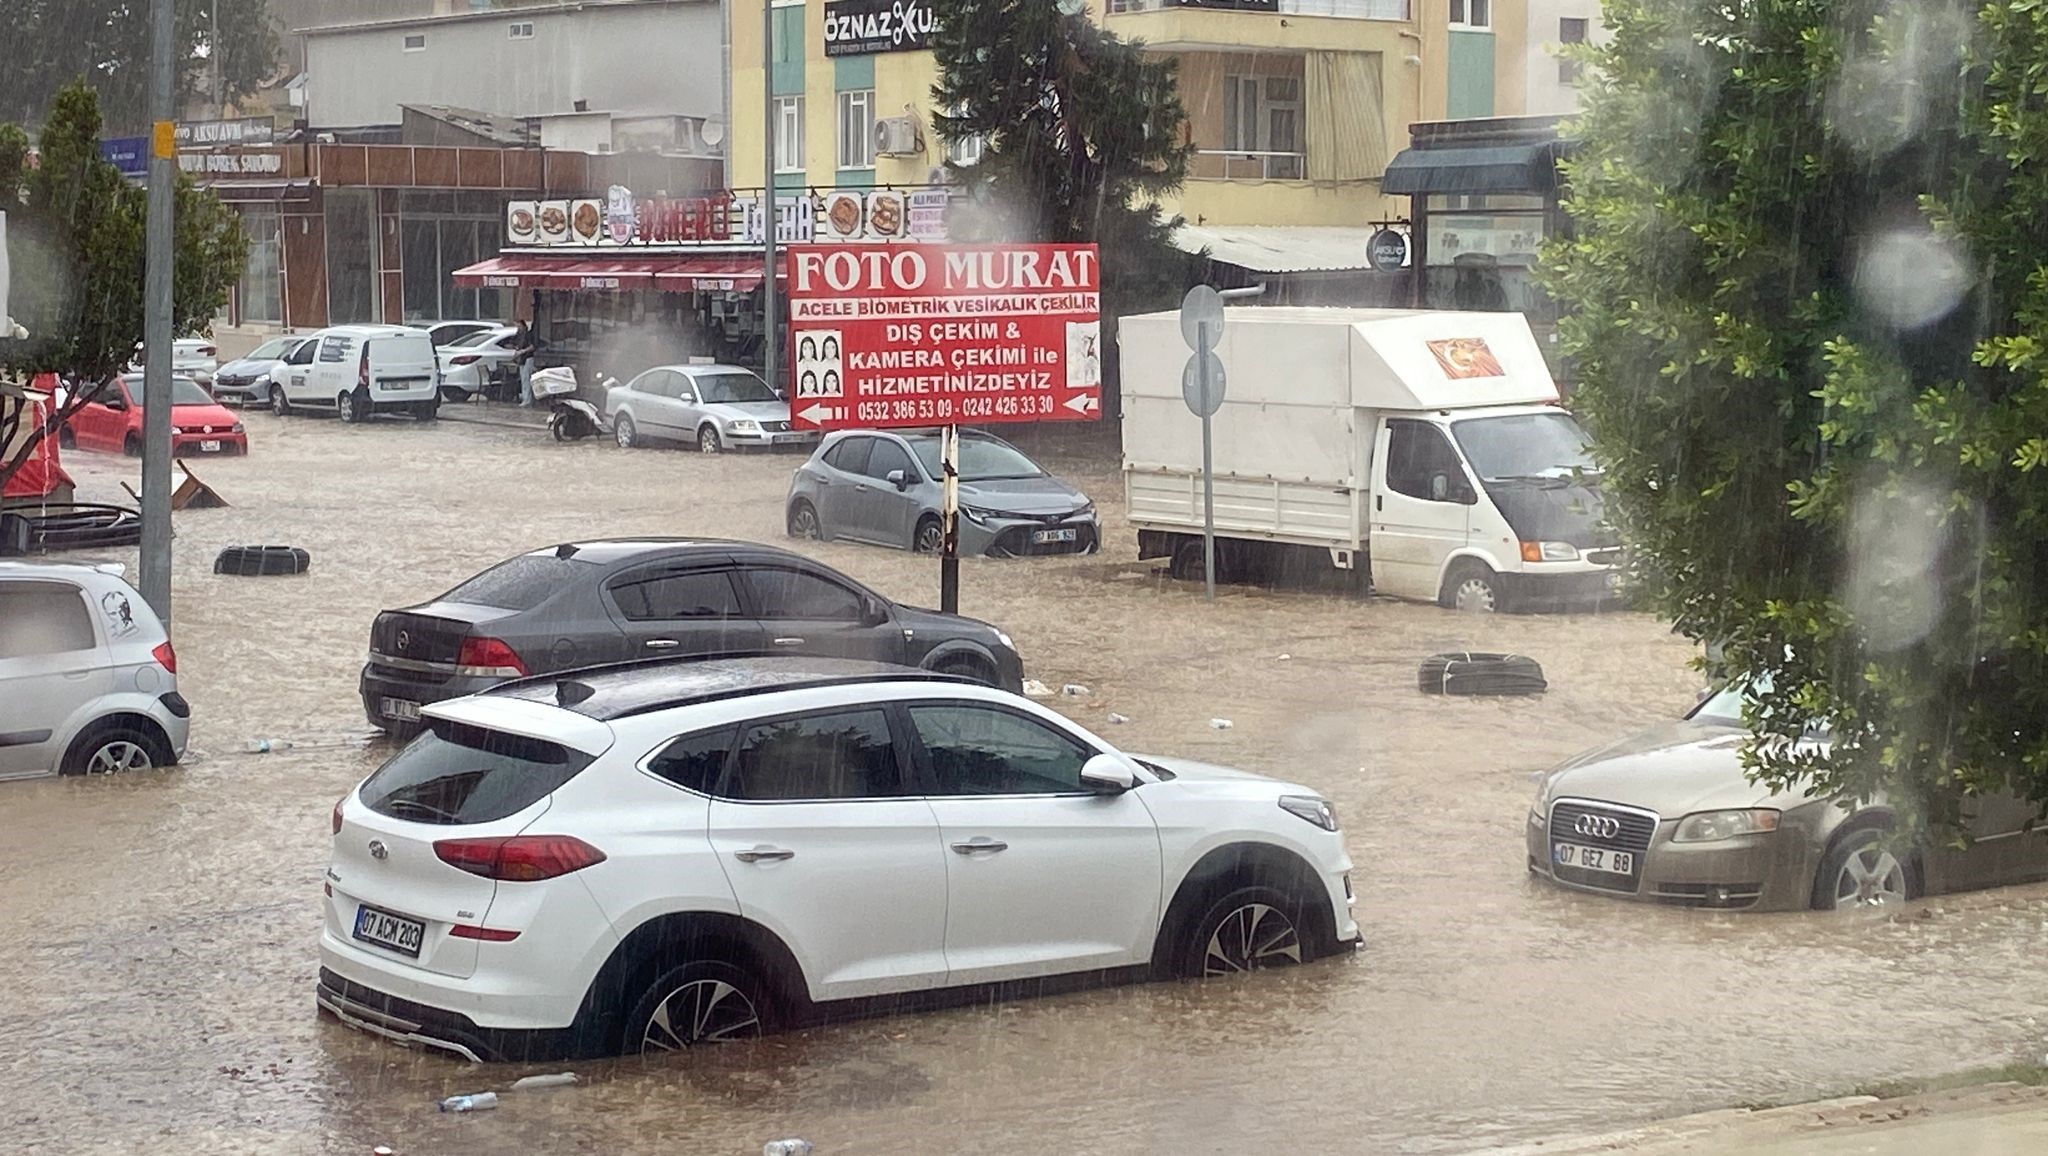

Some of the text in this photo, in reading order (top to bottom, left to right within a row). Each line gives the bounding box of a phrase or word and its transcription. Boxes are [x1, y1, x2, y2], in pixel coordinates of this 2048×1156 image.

[825, 10, 892, 42] ÖZNAZ
[795, 250, 1096, 291] FOTO MURAT
[798, 302, 852, 316] ACELE
[858, 297, 949, 315] BİOMETRİK
[953, 296, 1036, 313] VESİKALIK
[886, 320, 1021, 345] DIŞ ÇEKİM &
[849, 345, 1058, 370] KAMERA ÇEKİMİ ile
[858, 369, 1051, 396] HİZMETİNİZDEYİZ
[857, 403, 889, 420] 0532
[892, 403, 916, 419] 386
[918, 403, 934, 418] 53
[937, 402, 952, 418] 09
[962, 400, 992, 417] 0242
[995, 398, 1018, 415] 426
[1020, 397, 1036, 414] 33
[1038, 396, 1054, 413] 30
[1560, 845, 1575, 863] 07
[1581, 848, 1604, 868] GEZ
[362, 911, 420, 948] 07 ACM 203
